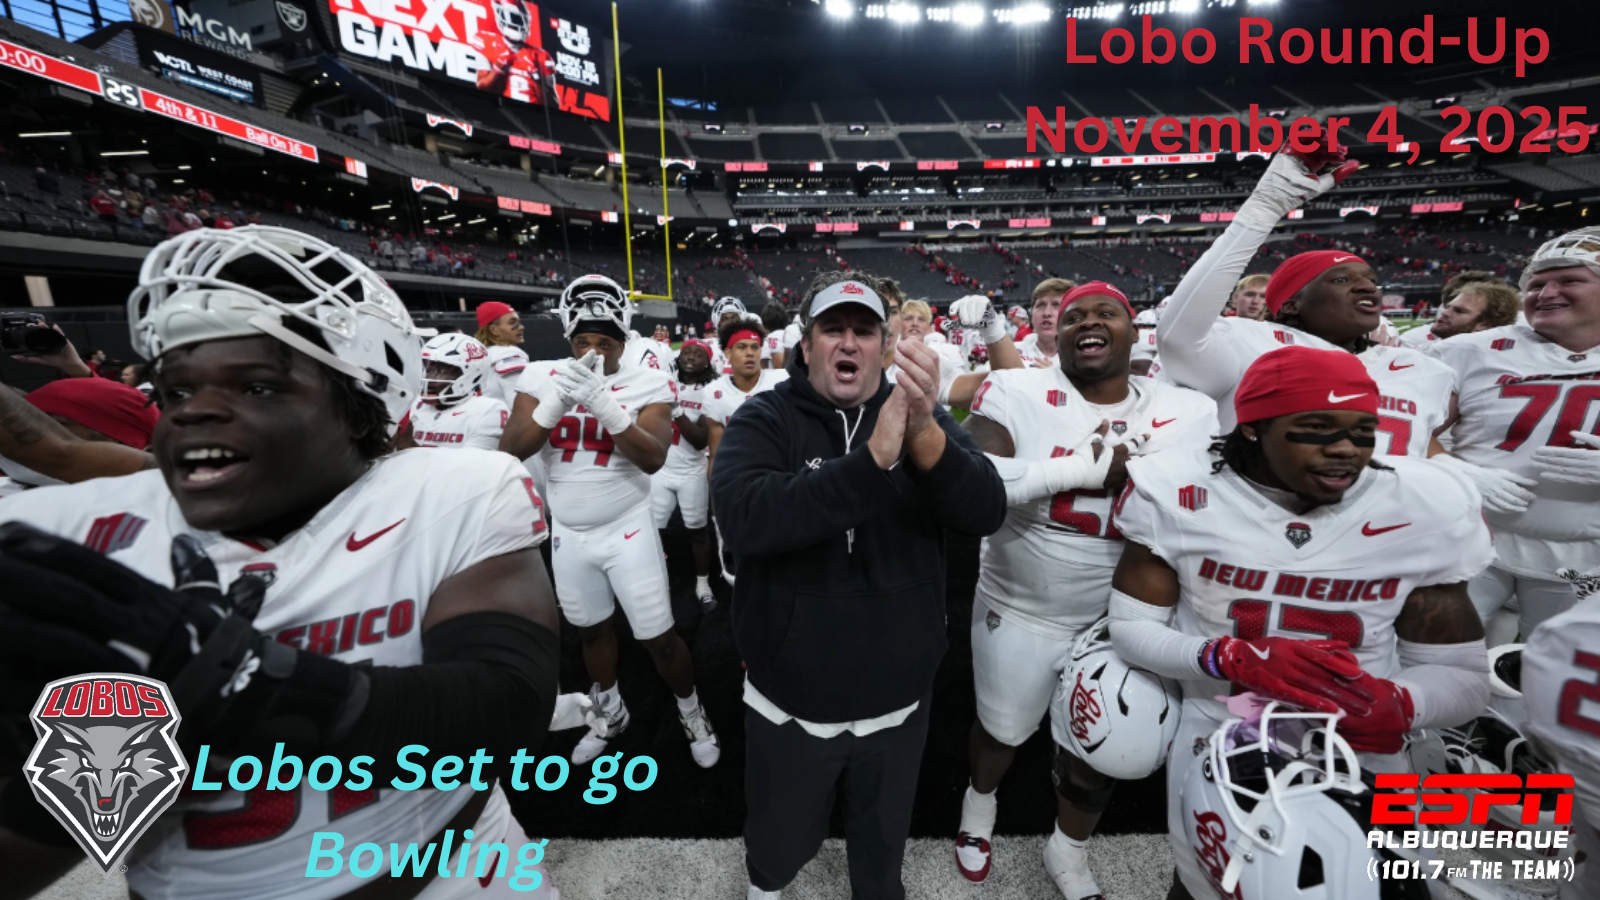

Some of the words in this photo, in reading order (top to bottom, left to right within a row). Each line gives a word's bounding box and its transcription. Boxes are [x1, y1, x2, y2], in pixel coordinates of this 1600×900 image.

[176, 5, 252, 51] MGM
[181, 29, 256, 63] REWARDS
[337, 9, 491, 83] GAME
[106, 79, 138, 106] 25
[155, 98, 182, 117] 4th
[185, 109, 198, 122] &
[201, 113, 218, 129] 11
[246, 126, 268, 144] Ball
[270, 136, 287, 149] On
[289, 142, 303, 156] 16
[549, 416, 615, 468] 94
[1198, 557, 1269, 592] NEW
[1272, 572, 1402, 603] MEXICO
[1069, 671, 1102, 743] Lobos
